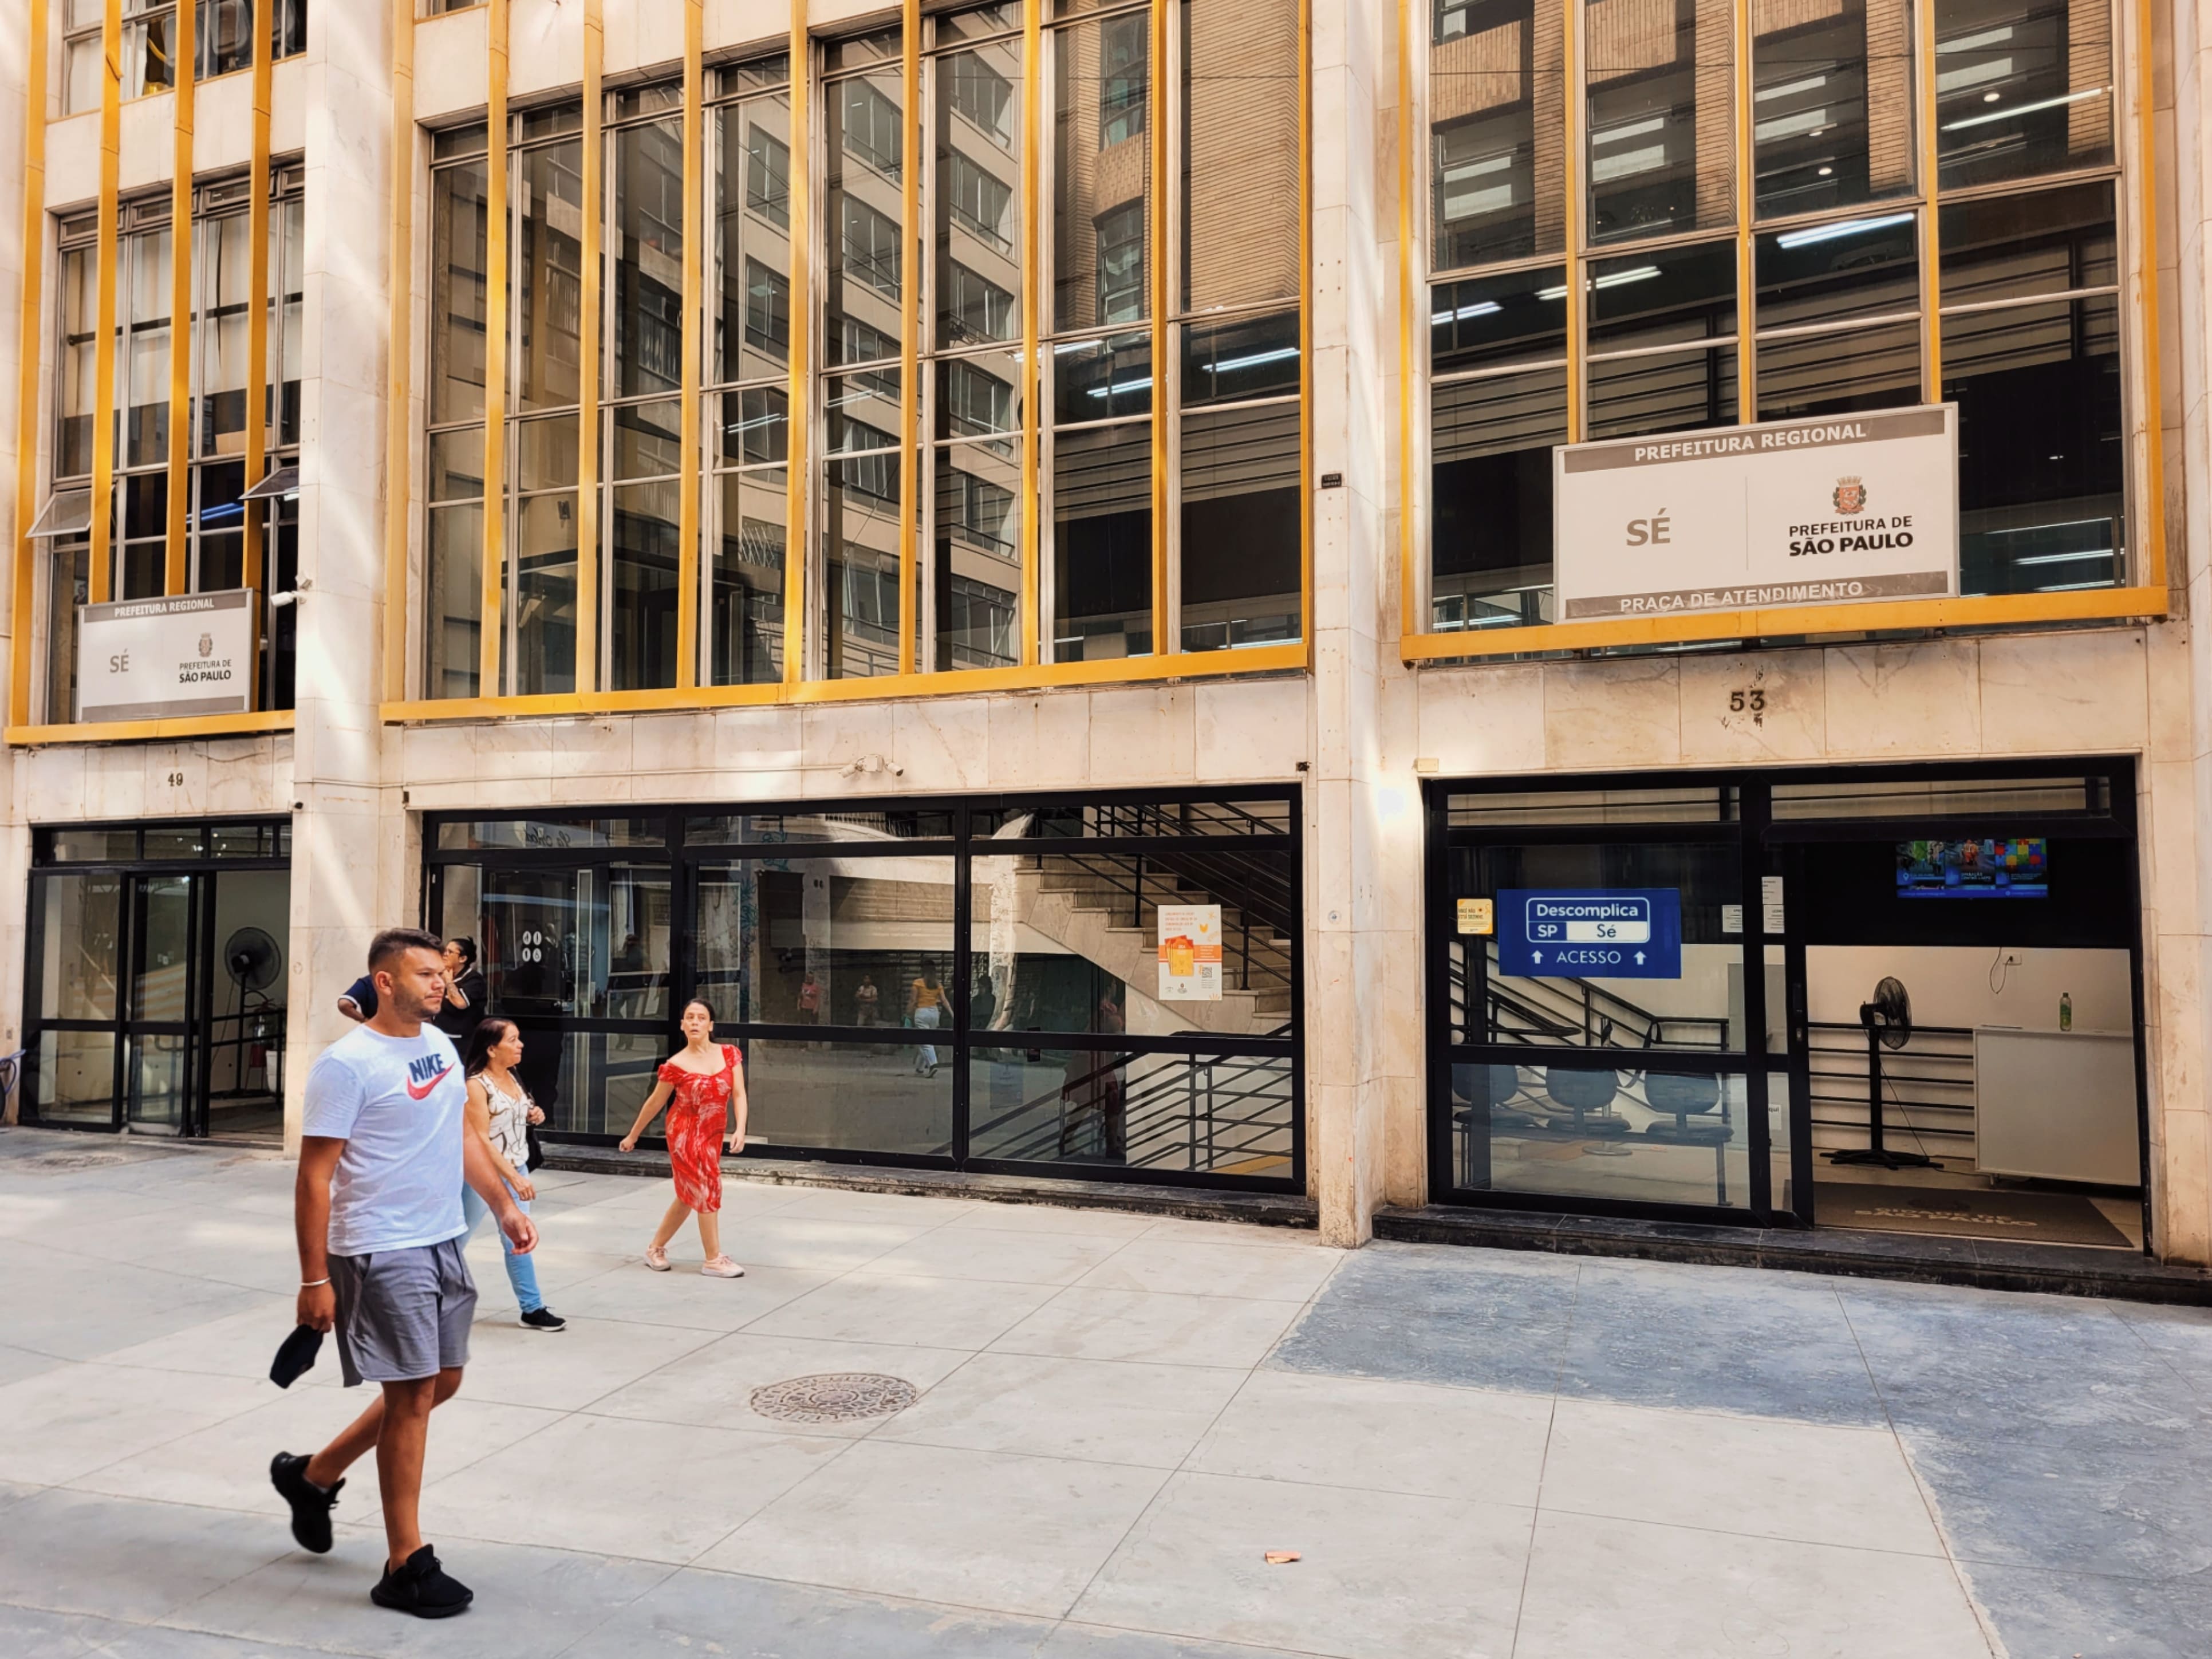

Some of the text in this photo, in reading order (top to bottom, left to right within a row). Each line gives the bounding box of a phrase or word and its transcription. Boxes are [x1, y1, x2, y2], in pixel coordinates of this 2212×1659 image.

[1634, 423, 1867, 462] PREFEITURA REGIONAL
[1626, 507, 1671, 546] SÉ
[1789, 515, 1913, 537] PREFEITURA DE
[1789, 531, 1914, 557] SÃO PAULO
[115, 598, 215, 617] PREFEITURA REGIONAL
[1620, 581, 1863, 613] PRAÇA DE ATENDIMENTO
[109, 648, 129, 673] SÉ
[179, 659, 232, 671] PREFEITURA DE
[179, 669, 232, 683] SÃO PAULO
[1729, 689, 1765, 712] 53
[168, 773, 183, 787] 49
[1536, 903, 1638, 919] Descomplica
[1537, 923, 1617, 938] SP Sé
[1556, 950, 1622, 964] ACESSO
[408, 1053, 446, 1083] NIKE
